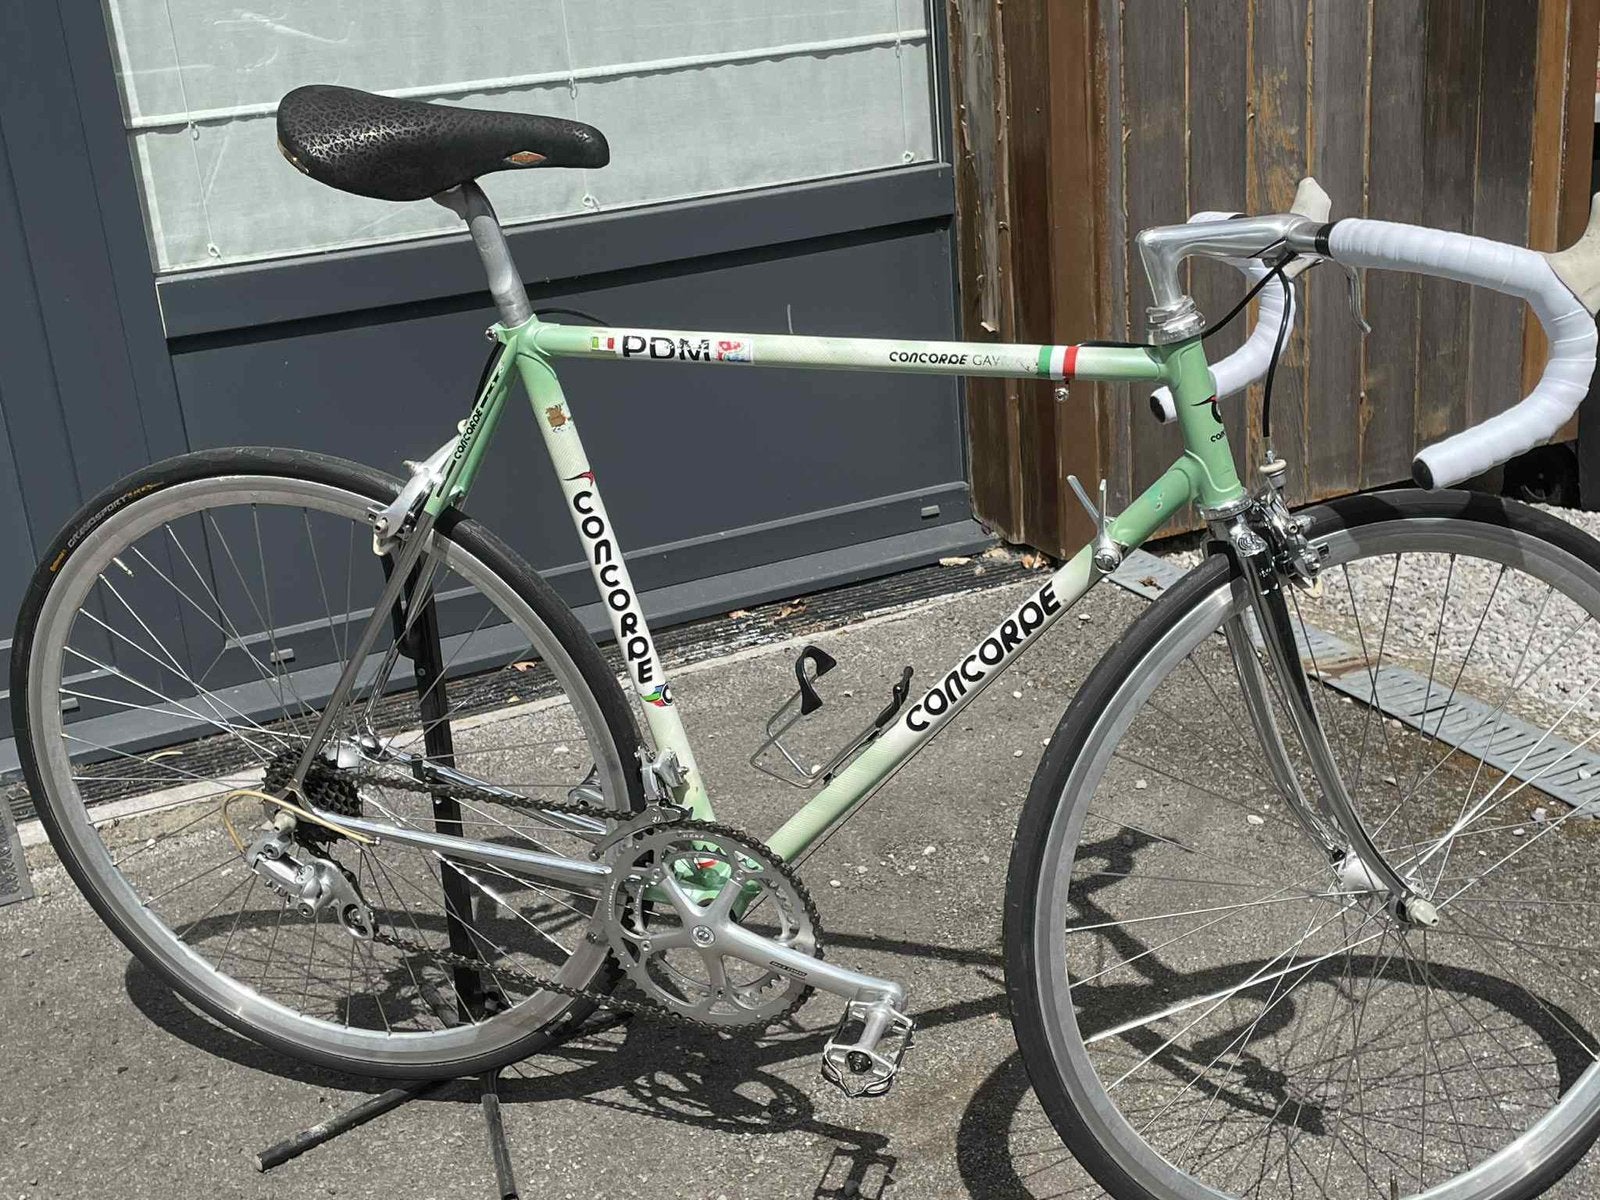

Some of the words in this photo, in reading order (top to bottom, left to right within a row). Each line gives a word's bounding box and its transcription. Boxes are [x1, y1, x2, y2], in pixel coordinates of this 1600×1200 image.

[622, 335, 711, 362] PDM
[889, 351, 969, 365] CONCORDE
[454, 408, 483, 460] CONCORDE
[573, 491, 654, 684] CONCORDE
[906, 580, 1062, 732] CONCORDE
